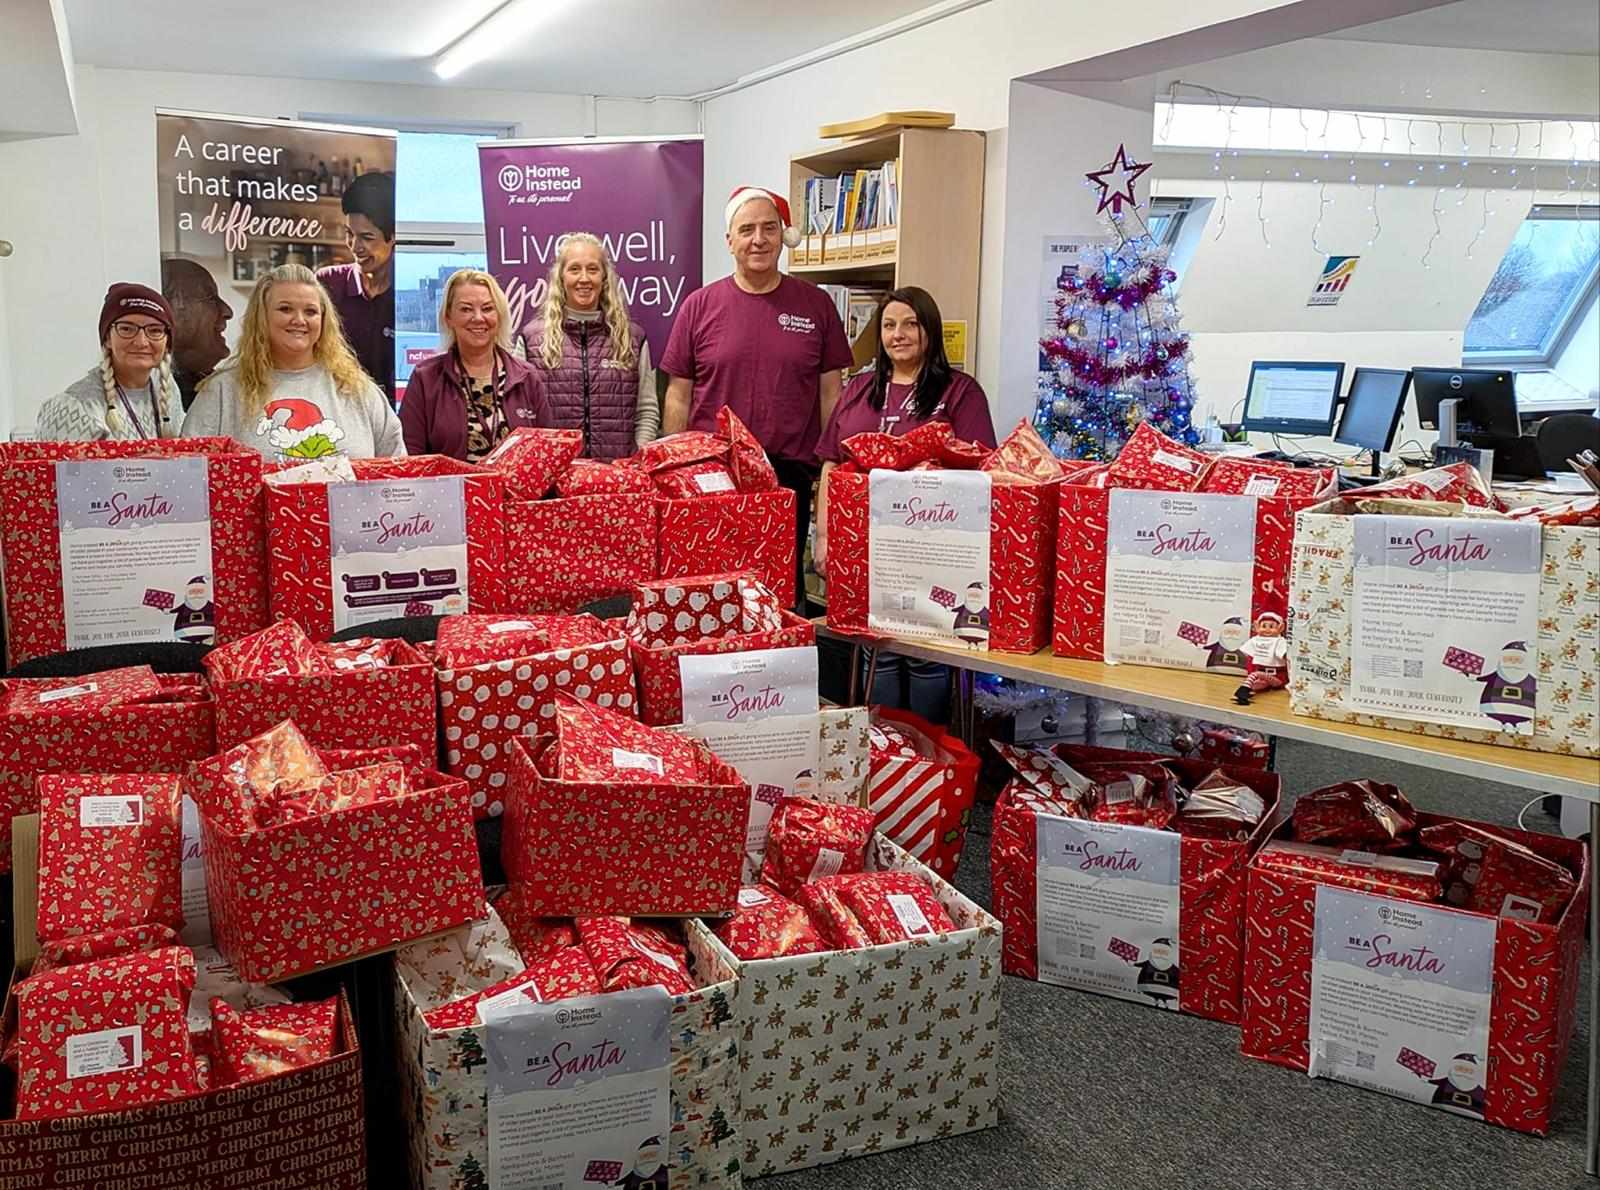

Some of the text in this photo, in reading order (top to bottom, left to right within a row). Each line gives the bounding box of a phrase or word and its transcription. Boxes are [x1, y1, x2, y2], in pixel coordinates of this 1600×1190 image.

[174, 134, 283, 166] A career
[176, 170, 318, 202] that makes
[526, 165, 570, 178] Home
[526, 176, 581, 191] Instead
[178, 201, 322, 252] a difference
[108, 492, 173, 526] Santa
[905, 497, 959, 526] Santa
[377, 512, 435, 544] Santa
[1152, 524, 1216, 556] Santa
[1390, 529, 1491, 565] BE A Santa
[727, 684, 784, 719] Santa
[1080, 841, 1143, 872] Santa
[1349, 937, 1361, 945] BE
[1366, 934, 1446, 974] Santa
[527, 1058, 538, 1066] BE
[547, 1038, 626, 1085] Santa
[0, 1120, 40, 1137] ERRY
[50, 1108, 144, 1132] CHRISTMAS
[155, 1096, 207, 1118] MERRY
[216, 1073, 302, 1106] CHRISTMAS
[312, 1055, 358, 1081] MERRY
[28, 1134, 81, 1152] MERRY
[90, 1118, 183, 1144] CHRISTMAS
[194, 1103, 245, 1128] MERRY
[252, 1080, 336, 1113] CHRISTMAS
[56, 1146, 109, 1166] MERRY
[118, 1129, 210, 1157] CHRISTMAS
[221, 1114, 270, 1138] MERRY
[278, 1089, 359, 1123] CHRISTMAS
[54, 1159, 147, 1184] CHRISTMAS
[158, 1146, 208, 1168] MERRY
[218, 1122, 303, 1155] CHRISTMAS
[314, 1105, 358, 1131] MERRY
[197, 1154, 246, 1177] MERRY
[255, 1129, 338, 1162] CHRISTMAS
[224, 1164, 272, 1188] MERRY
[280, 1138, 360, 1172] CHRISTMAS
[316, 1154, 360, 1180] MERRY
